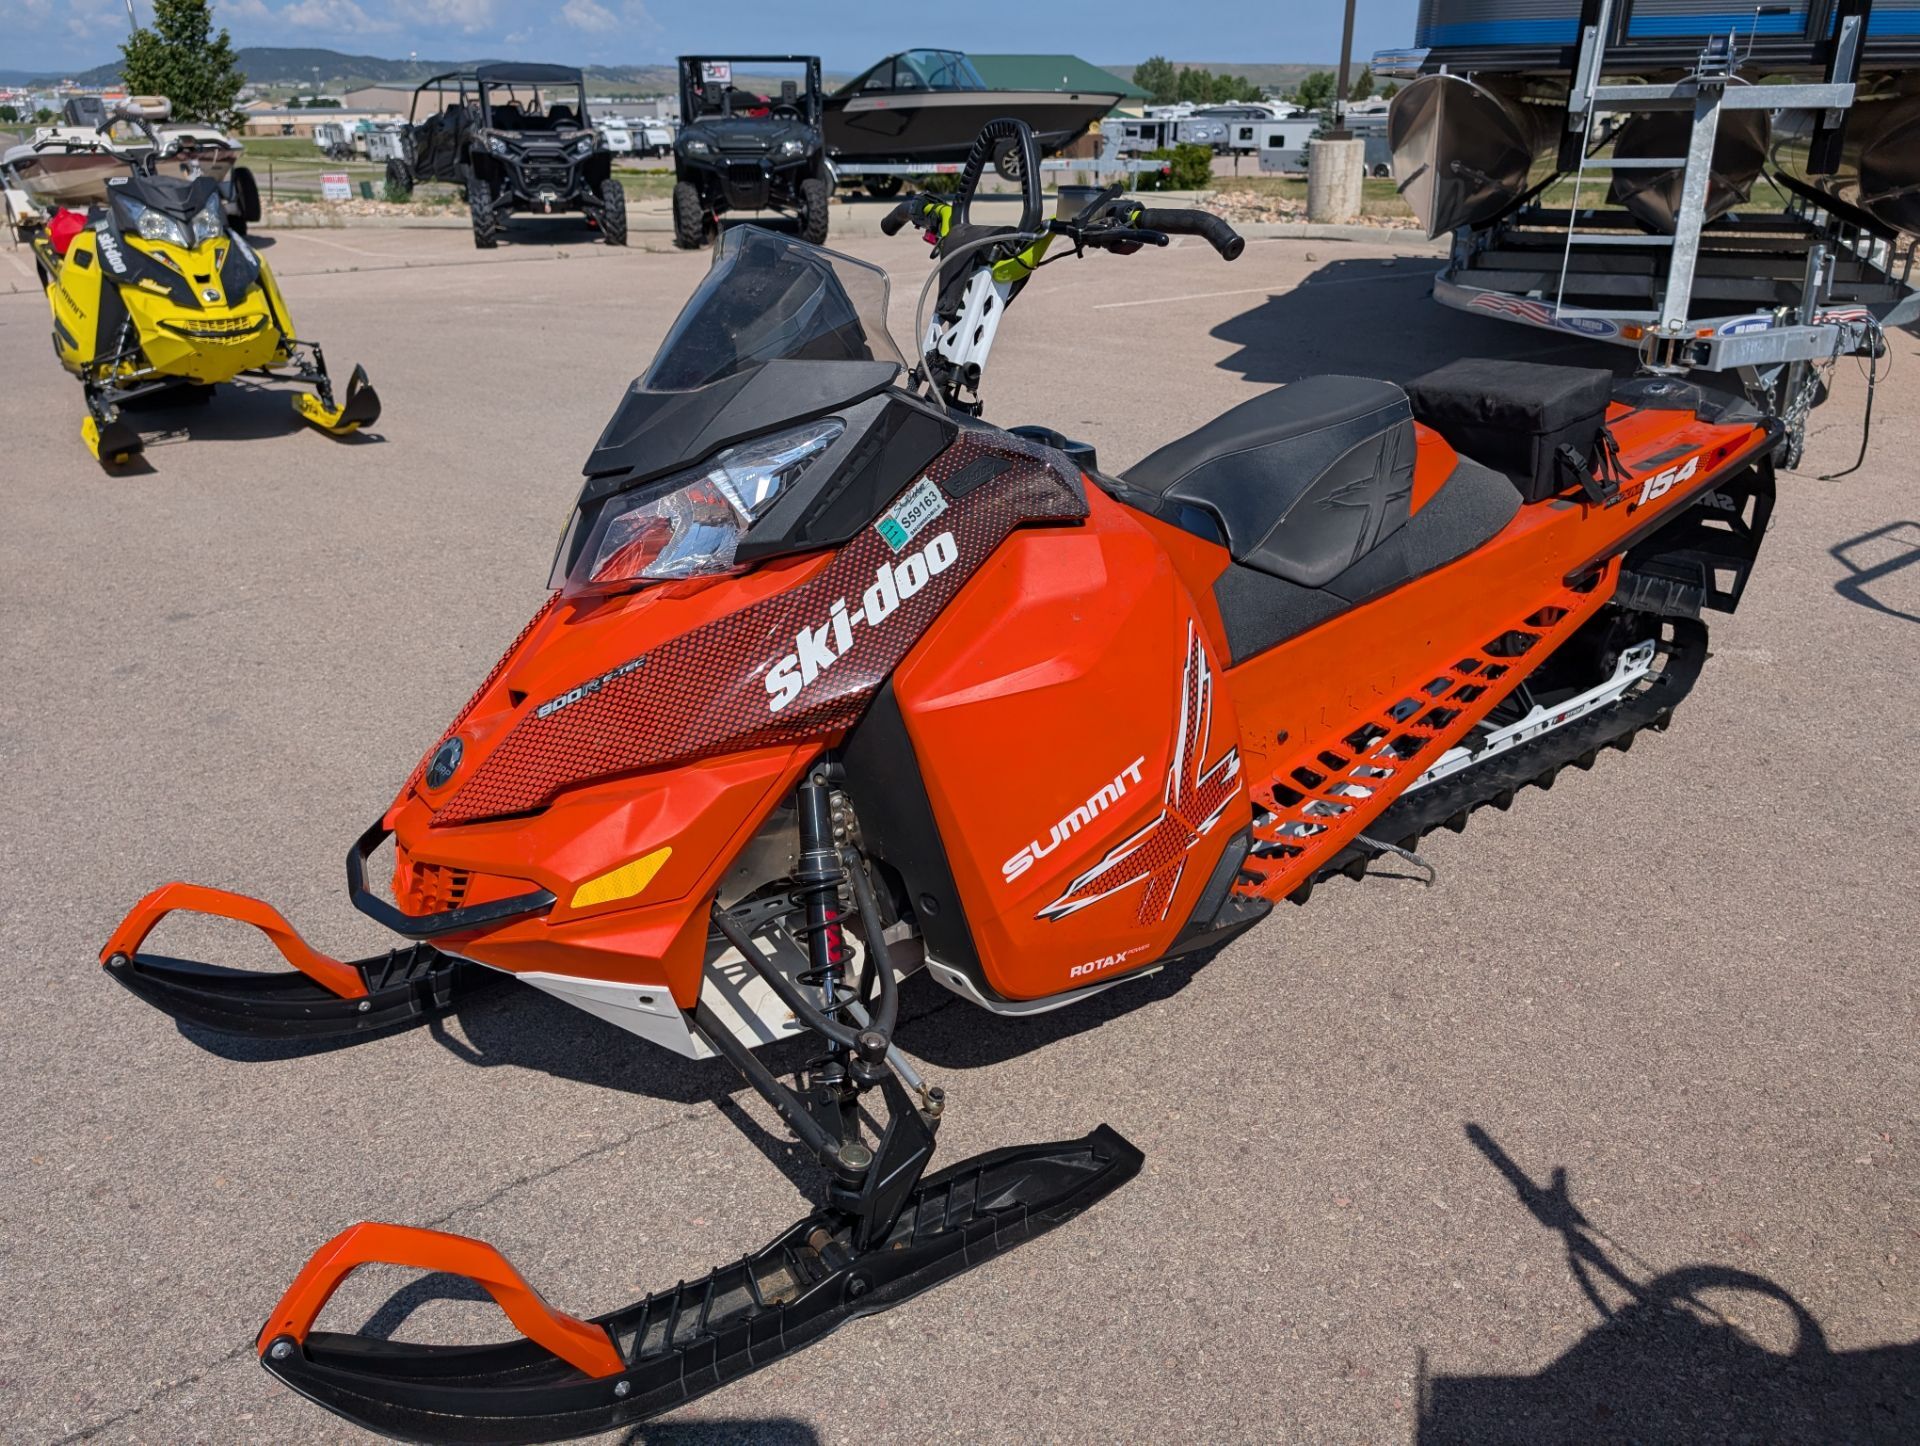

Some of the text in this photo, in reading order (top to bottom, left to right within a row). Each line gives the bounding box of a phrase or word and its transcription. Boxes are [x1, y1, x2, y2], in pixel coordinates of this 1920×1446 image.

[1637, 456, 1699, 506] 154
[901, 490, 938, 528] S59163
[910, 504, 941, 535] SNOWMOBILE
[765, 531, 959, 713] ski-doo
[538, 657, 647, 718] 800R E-TEC
[435, 762, 451, 776] BRP
[1002, 755, 1145, 884] SUMMIT
[1070, 943, 1150, 978] ROTAX POWER
